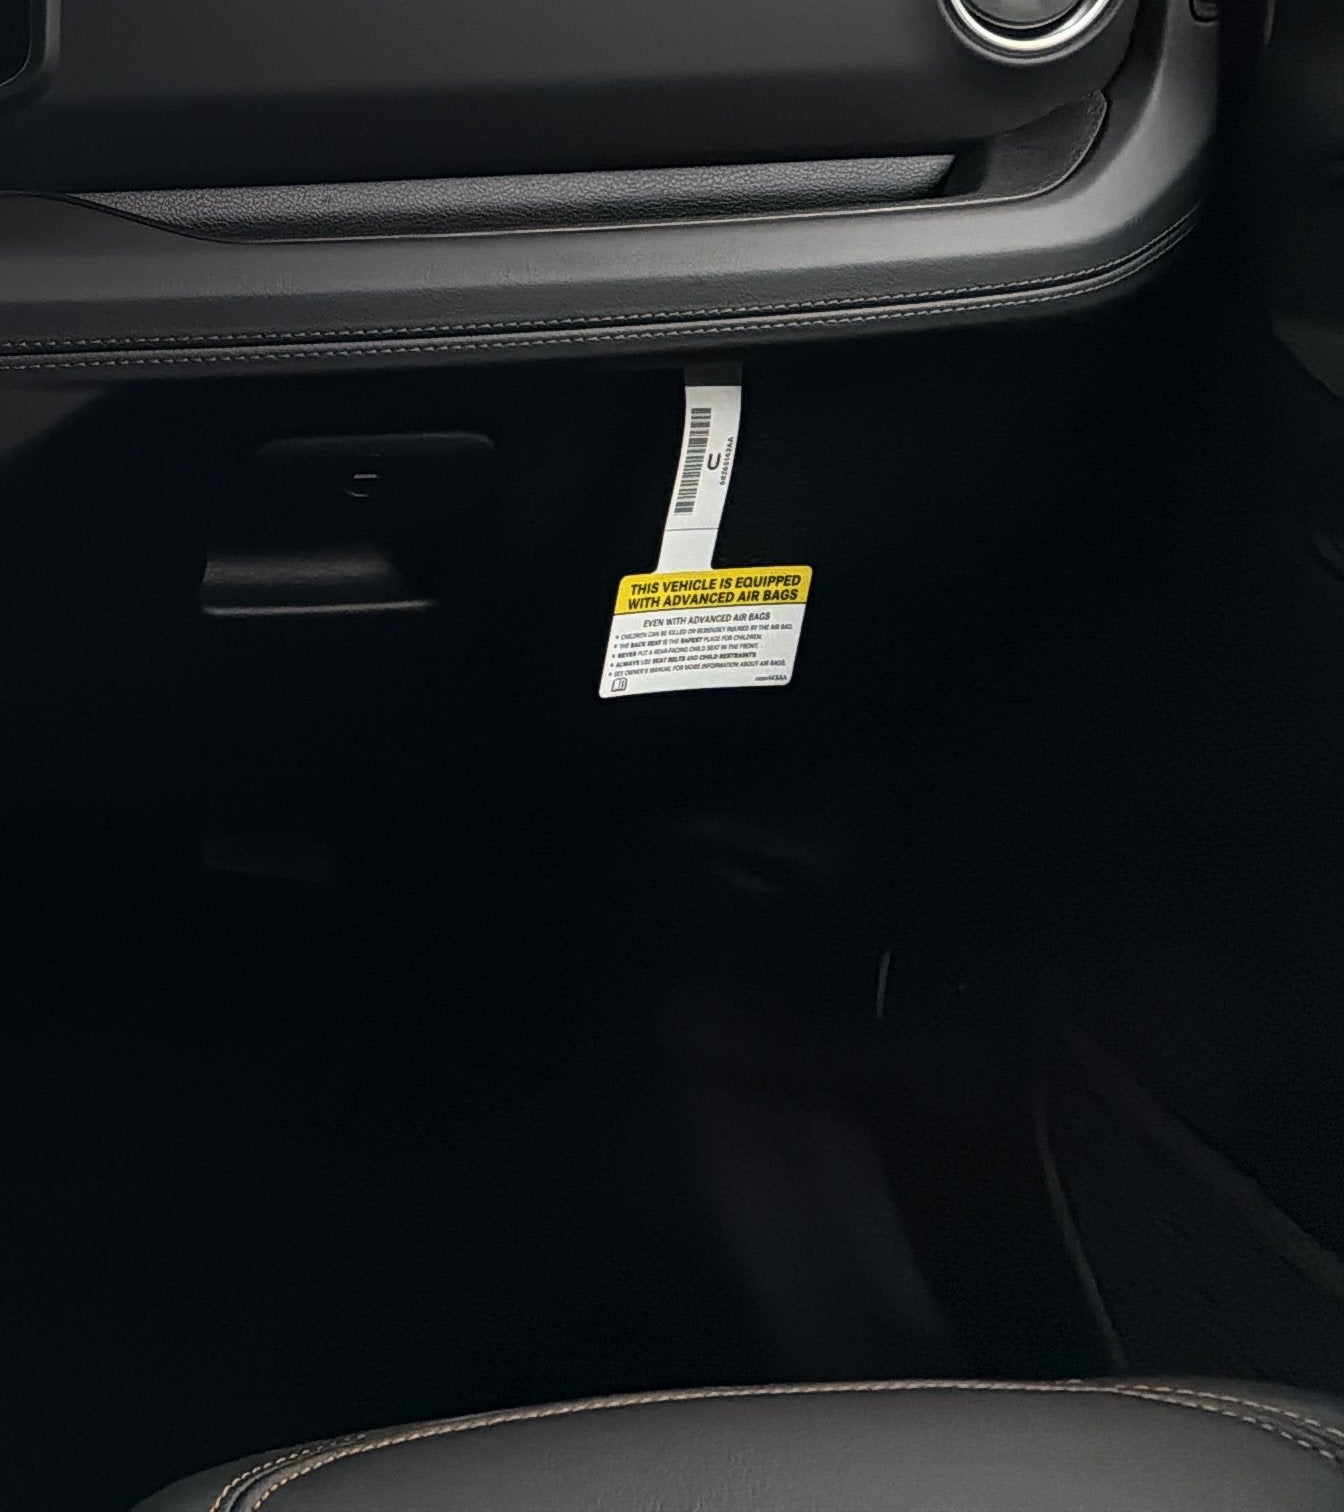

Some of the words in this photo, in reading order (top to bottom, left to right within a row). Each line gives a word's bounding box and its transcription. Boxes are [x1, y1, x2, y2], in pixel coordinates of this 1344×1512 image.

[707, 452, 722, 470] U
[630, 582, 659, 596] THIS
[662, 579, 716, 594] VEHICLE
[718, 577, 732, 589] IS
[734, 574, 801, 589] EQUIPPED
[627, 596, 660, 611] WITH
[662, 592, 735, 607] ADVANCED
[736, 590, 761, 603] AIR
[762, 588, 799, 601] BAGS
[642, 619, 664, 629] EVEN
[665, 616, 687, 627] WITH
[687, 614, 732, 625] ADVANCED
[732, 613, 748, 622] AIR
[748, 611, 771, 622] BAGS
